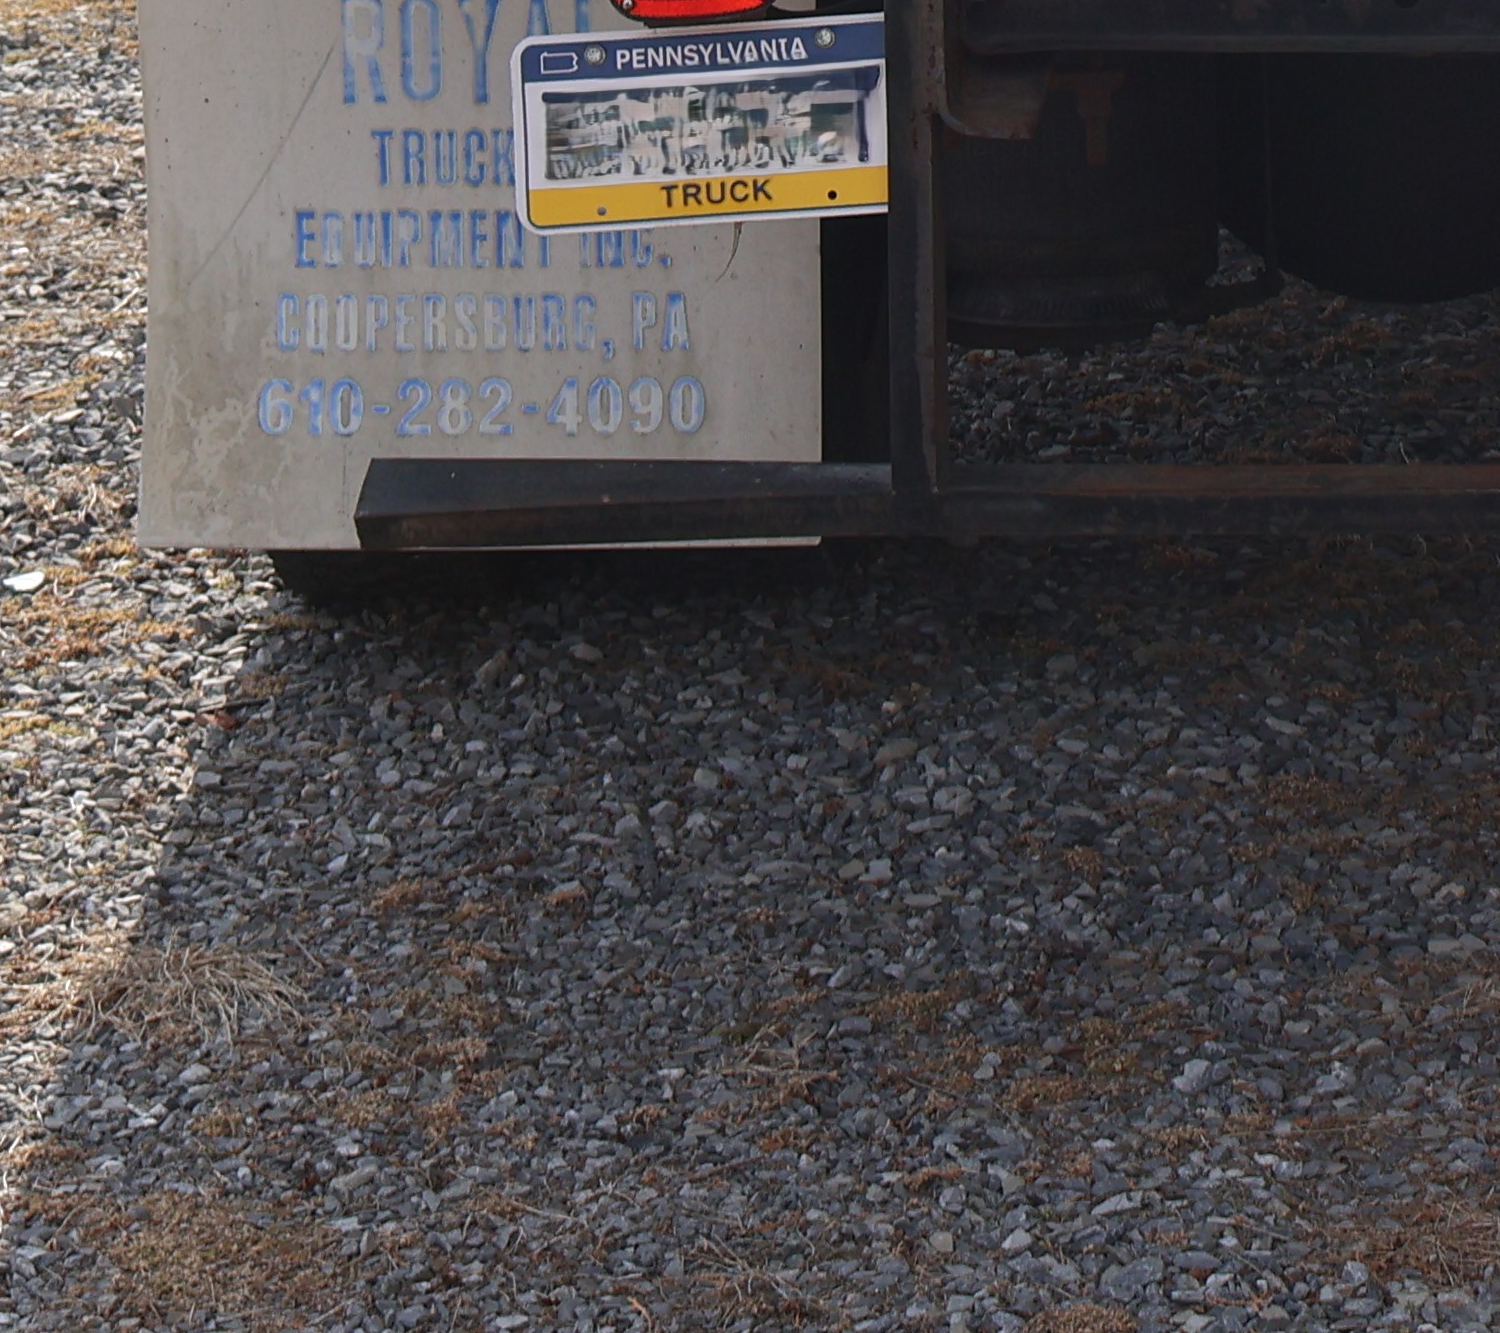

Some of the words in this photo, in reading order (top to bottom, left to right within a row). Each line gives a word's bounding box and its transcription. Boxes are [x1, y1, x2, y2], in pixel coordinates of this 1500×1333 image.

[615, 36, 808, 71] PENNSYLVANIA
[371, 129, 515, 186] TRUCK
[660, 178, 773, 209] TRUCK
[275, 292, 616, 360] COOPERSBURG,
[631, 291, 691, 352] PA
[257, 375, 708, 436] 610-282-4090
